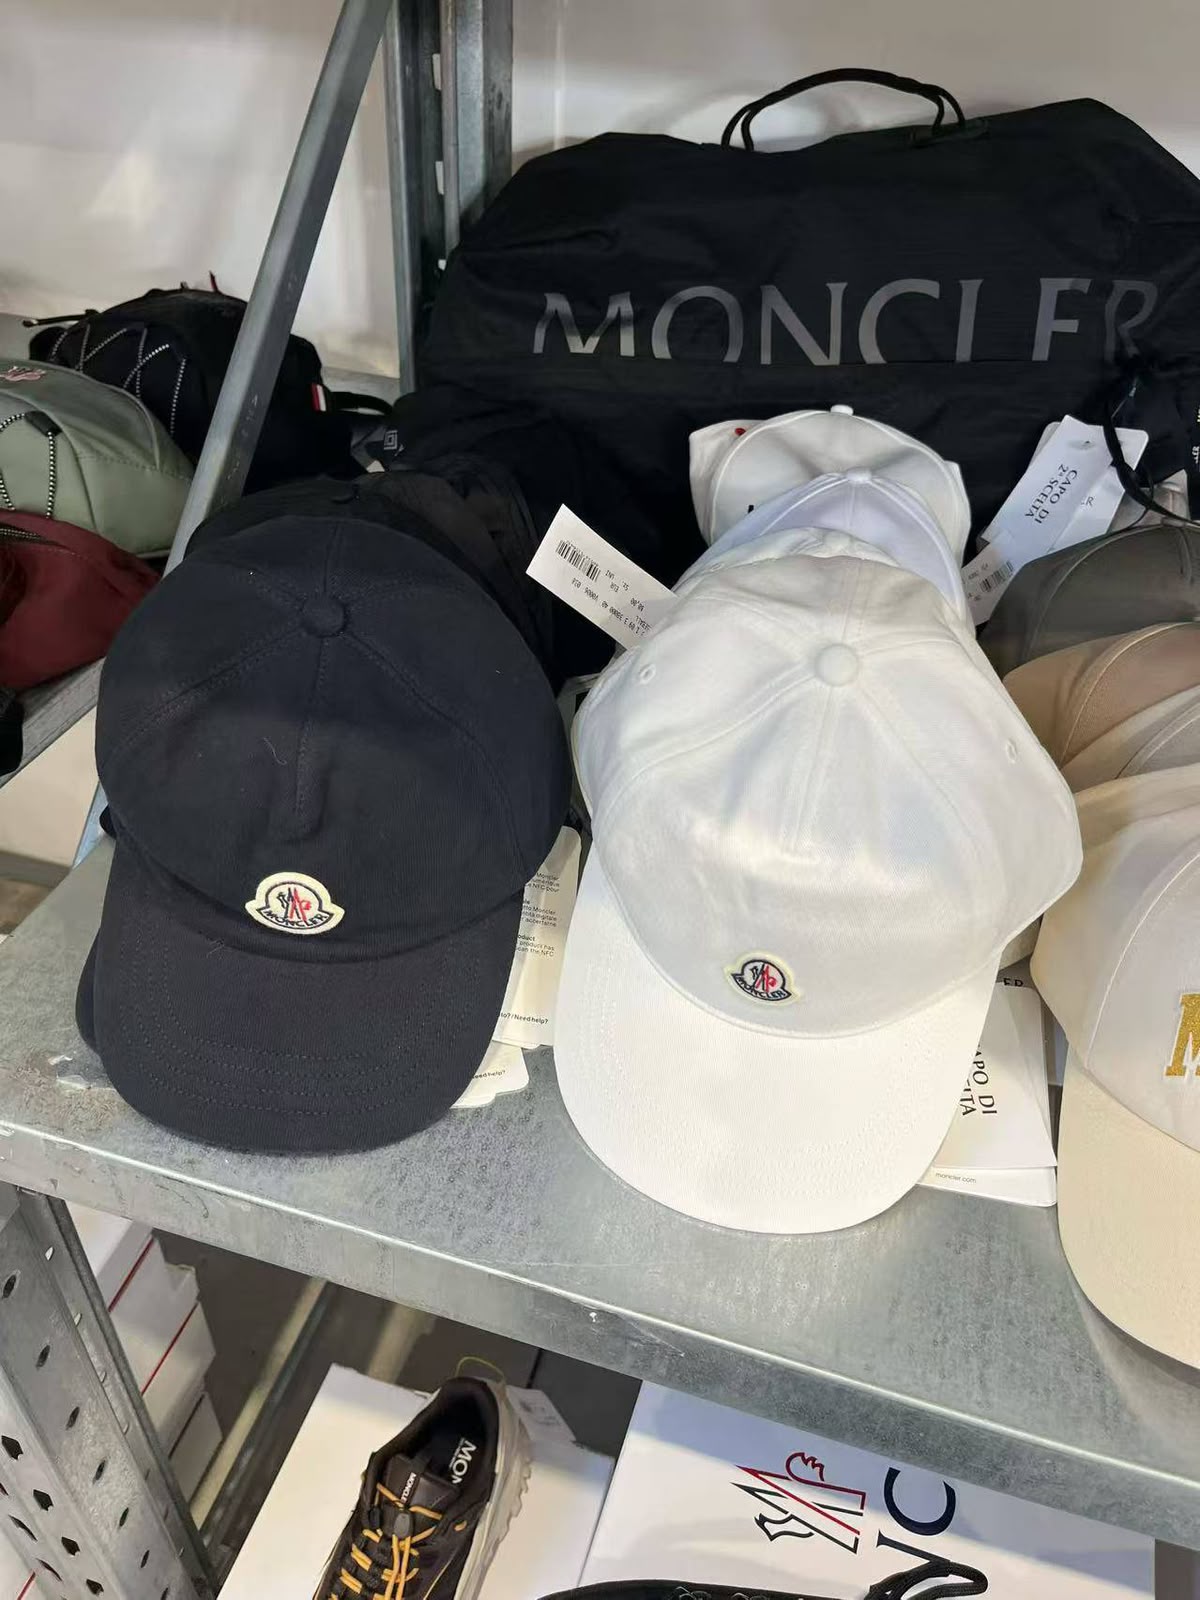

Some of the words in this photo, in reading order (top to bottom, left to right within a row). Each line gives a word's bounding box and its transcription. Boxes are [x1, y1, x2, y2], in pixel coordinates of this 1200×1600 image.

[1049, 469, 1078, 504] CAPO
[1025, 479, 1059, 517] SCELTA
[1034, 508, 1050, 524] DI
[264, 910, 328, 928] MONCLER
[514, 1014, 531, 1022] Need
[531, 1017, 549, 1025] help?
[979, 1095, 998, 1114] DI
